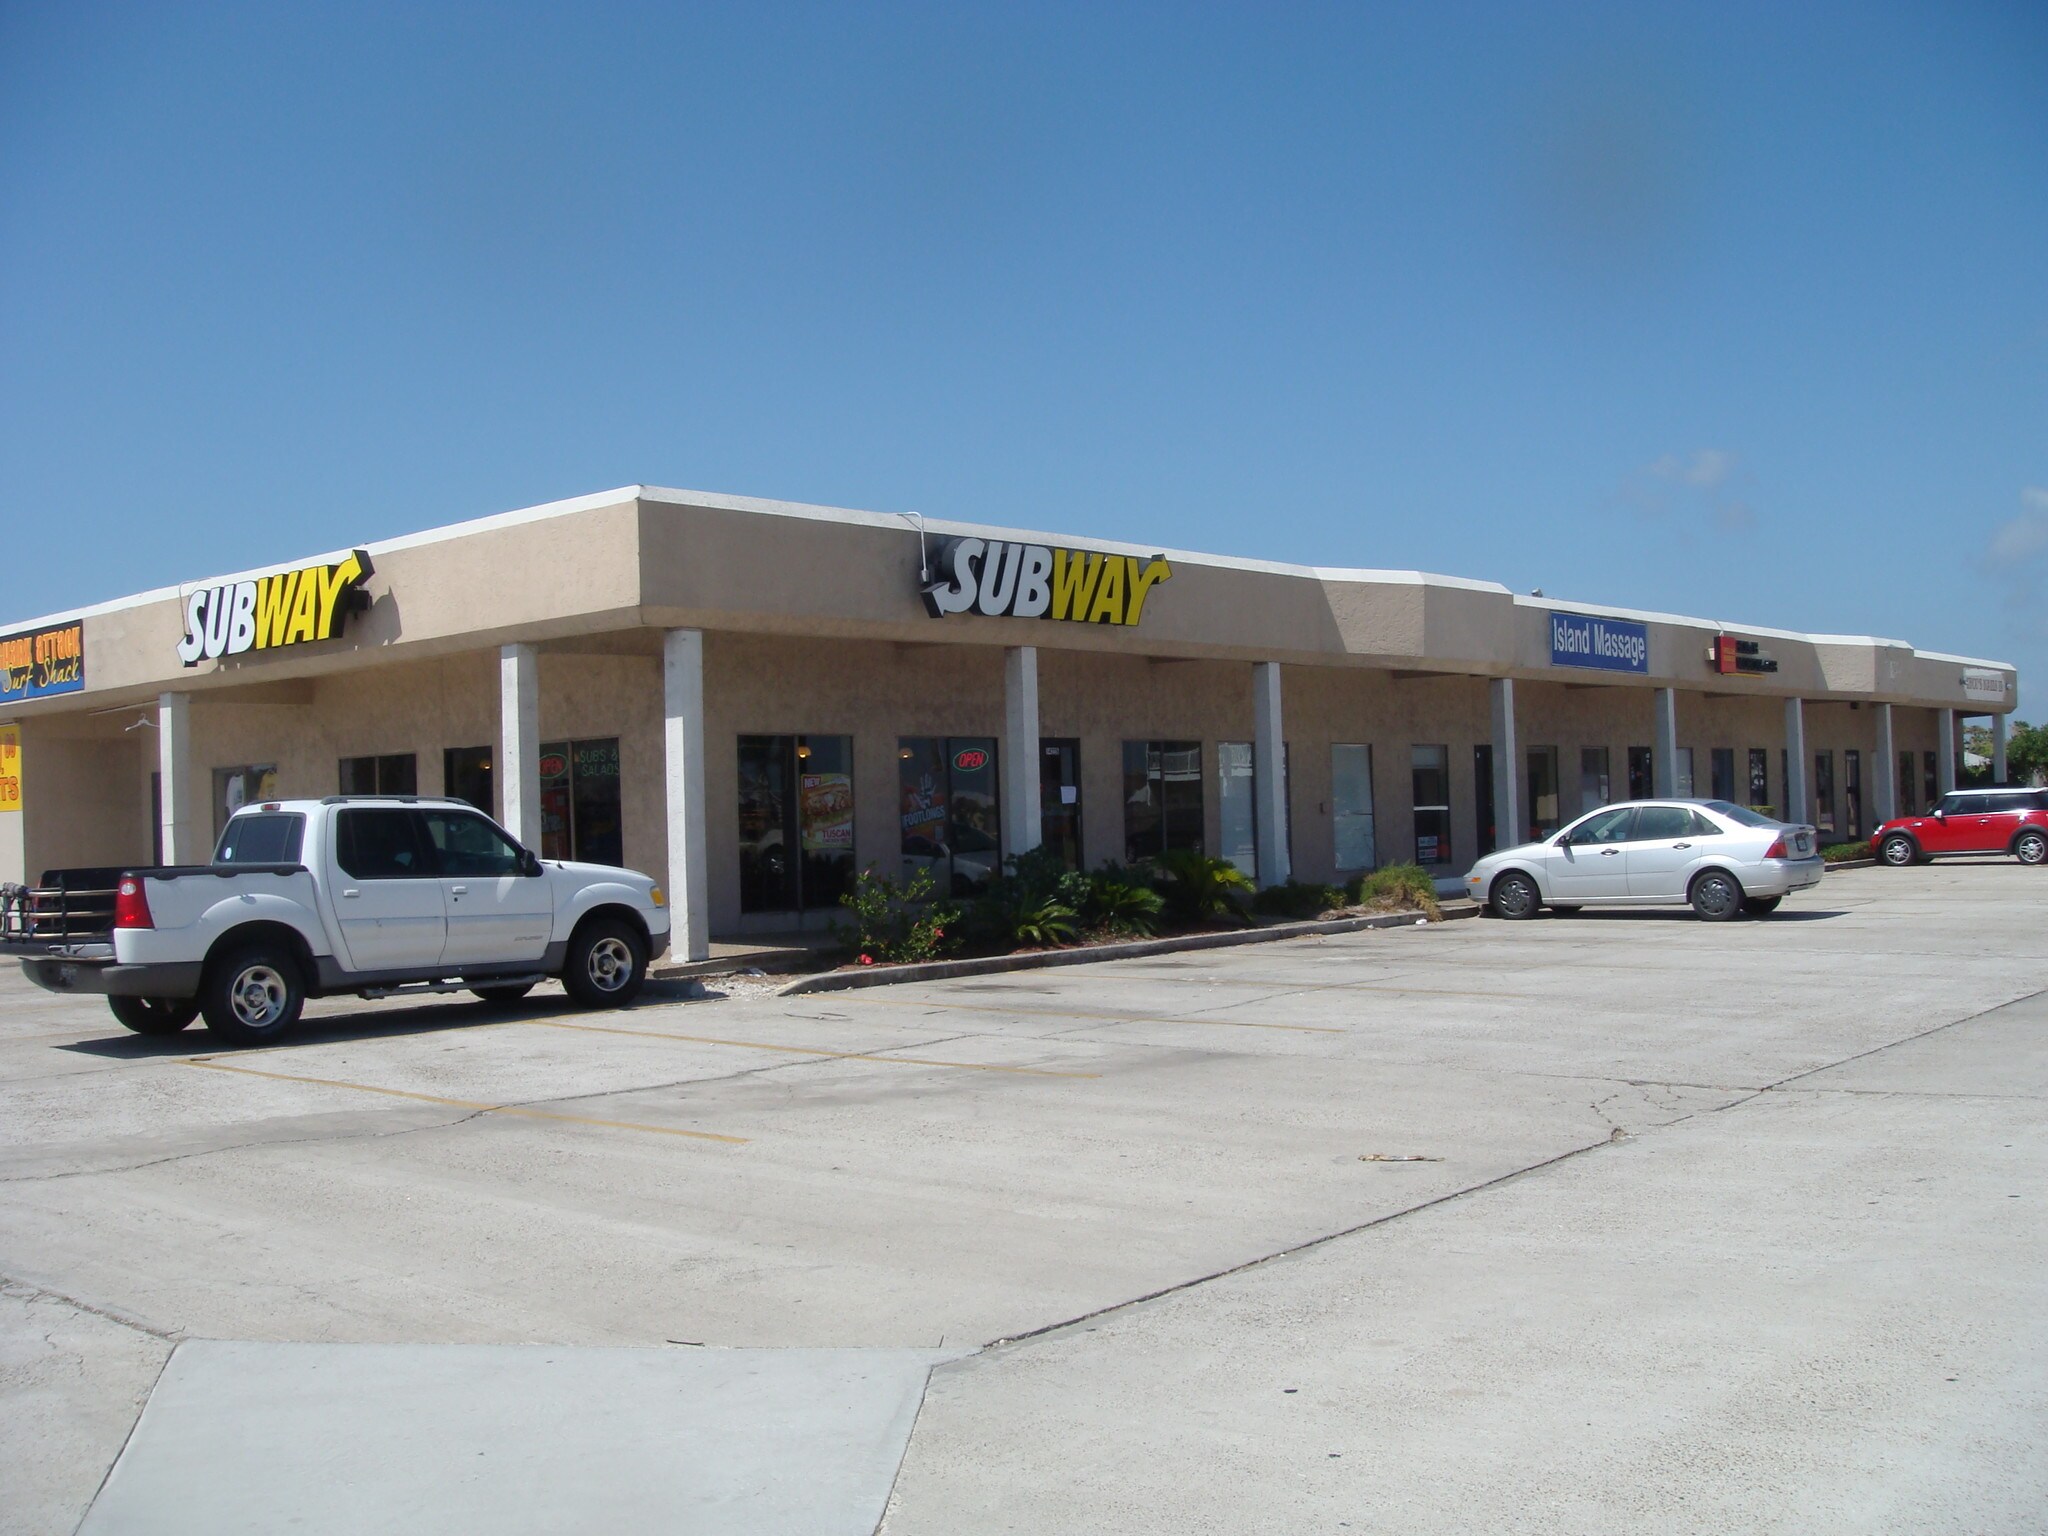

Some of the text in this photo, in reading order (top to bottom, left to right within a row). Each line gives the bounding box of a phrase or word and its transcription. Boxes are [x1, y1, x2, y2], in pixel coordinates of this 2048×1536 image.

[933, 537, 1172, 626] SUBWAY
[176, 550, 363, 667] SUBWAY
[1553, 618, 1646, 667] Island Massage
[3, 656, 80, 698] Surf Shack
[580, 749, 607, 763] SUBS
[959, 751, 984, 768] OPEN
[581, 762, 620, 777] SALADS
[803, 777, 821, 789] NEW
[822, 828, 851, 838] TUSCAN
